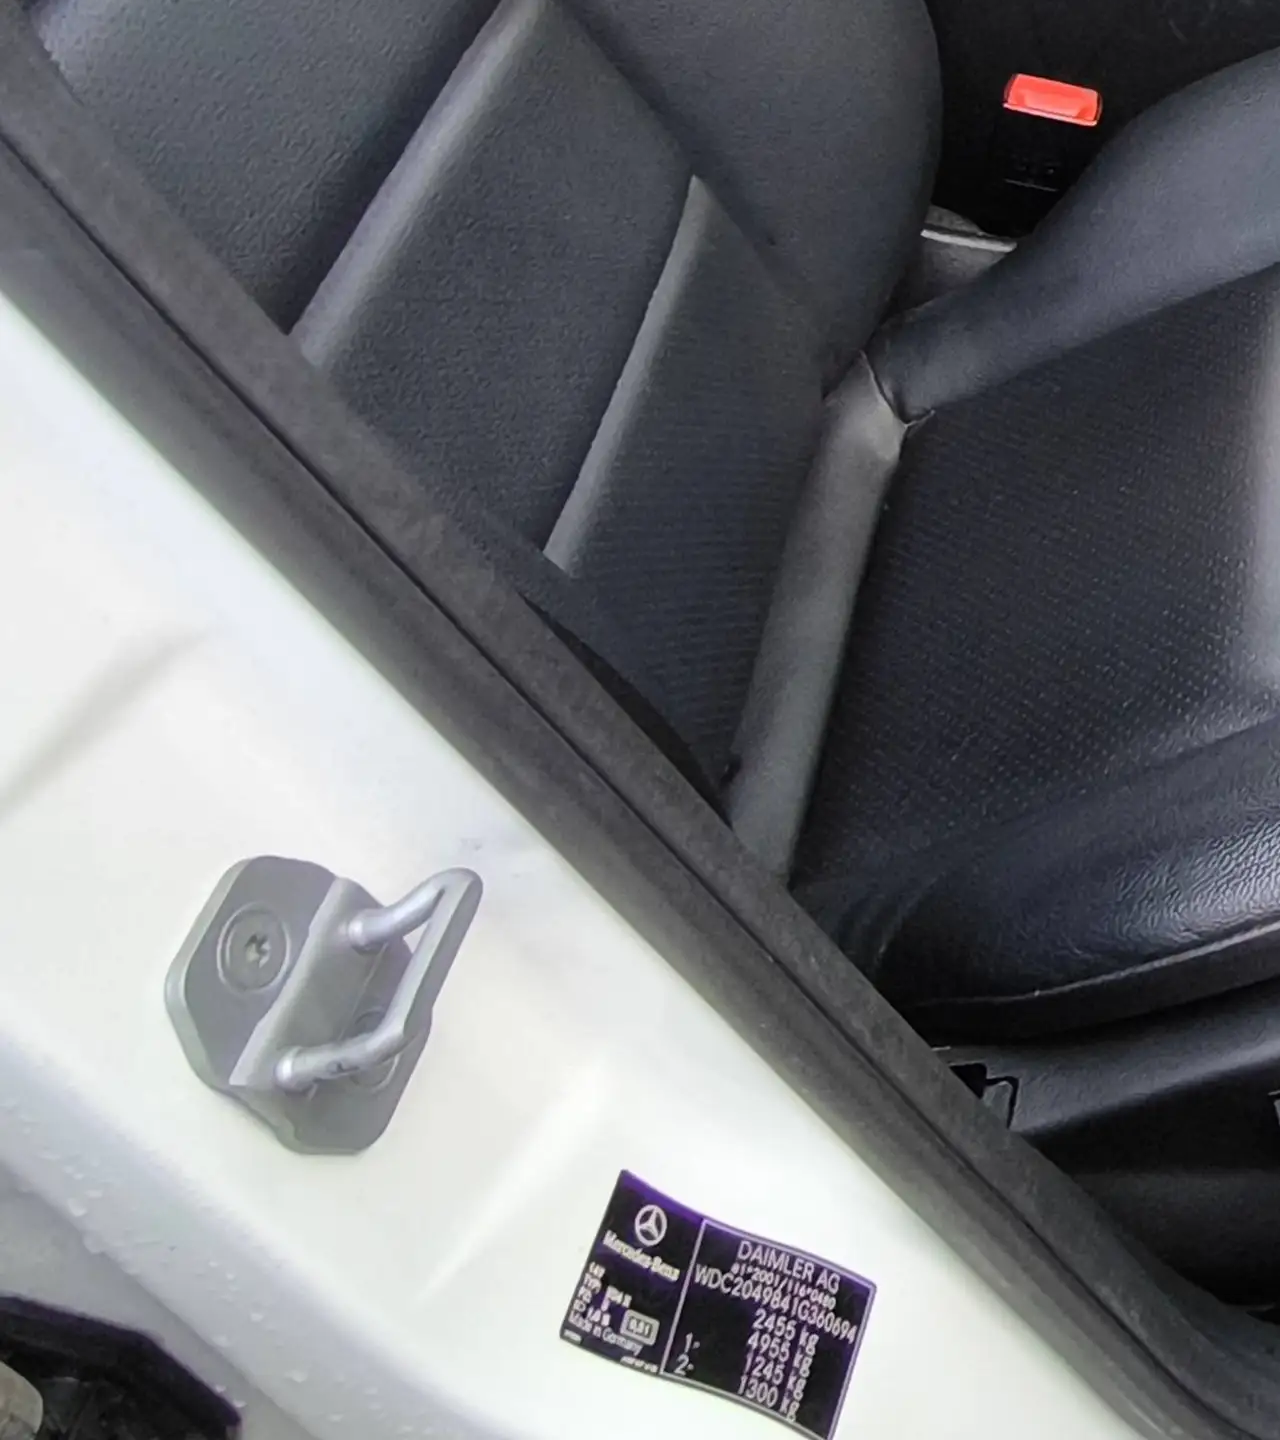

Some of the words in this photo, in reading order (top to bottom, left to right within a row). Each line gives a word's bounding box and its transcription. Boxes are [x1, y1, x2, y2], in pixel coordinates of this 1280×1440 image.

[737, 1240, 814, 1283] DAIMLER
[817, 1267, 841, 1295] AG
[748, 1330, 791, 1362] 4955
[793, 1348, 814, 1377] kg
[753, 1308, 797, 1340] 2455
[799, 1327, 819, 1355] kg
[738, 1375, 779, 1407] 1300
[744, 1350, 785, 1385] 1245
[786, 1371, 807, 1401] kg
